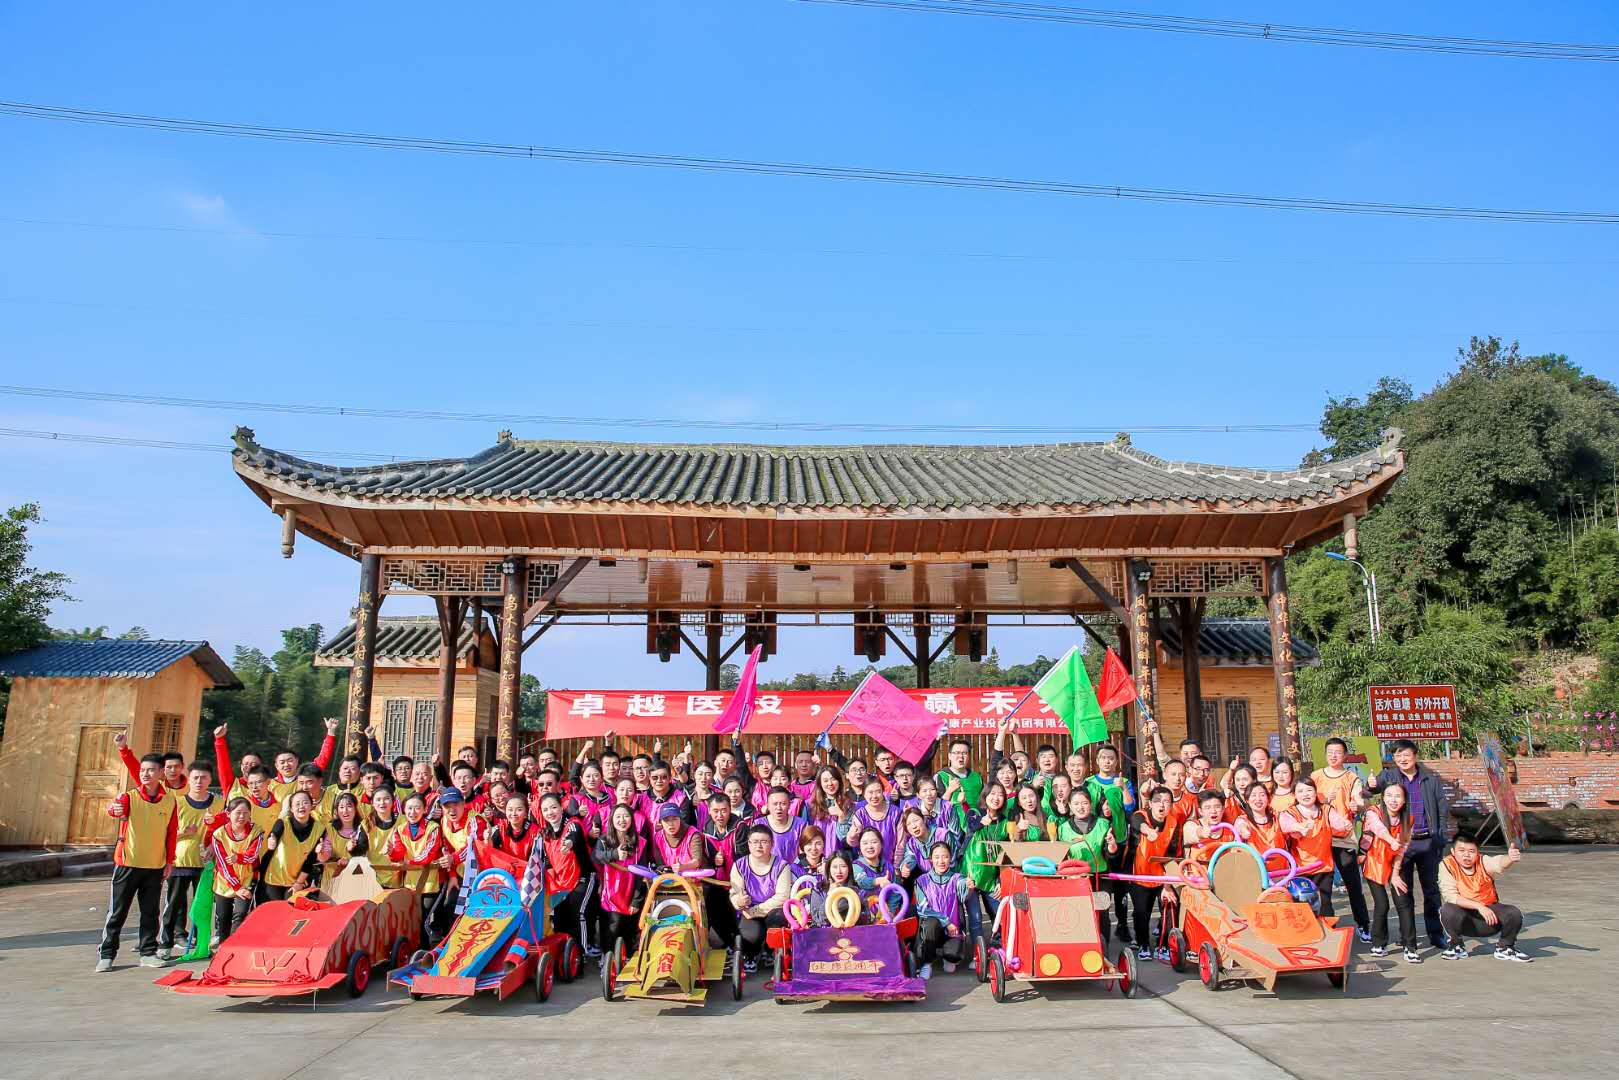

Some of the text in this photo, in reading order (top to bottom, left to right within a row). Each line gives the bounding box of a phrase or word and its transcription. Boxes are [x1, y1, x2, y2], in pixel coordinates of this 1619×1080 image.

[1374, 696, 1450, 711] 活水鱼塘 对外开放
[288, 918, 312, 937] 1
